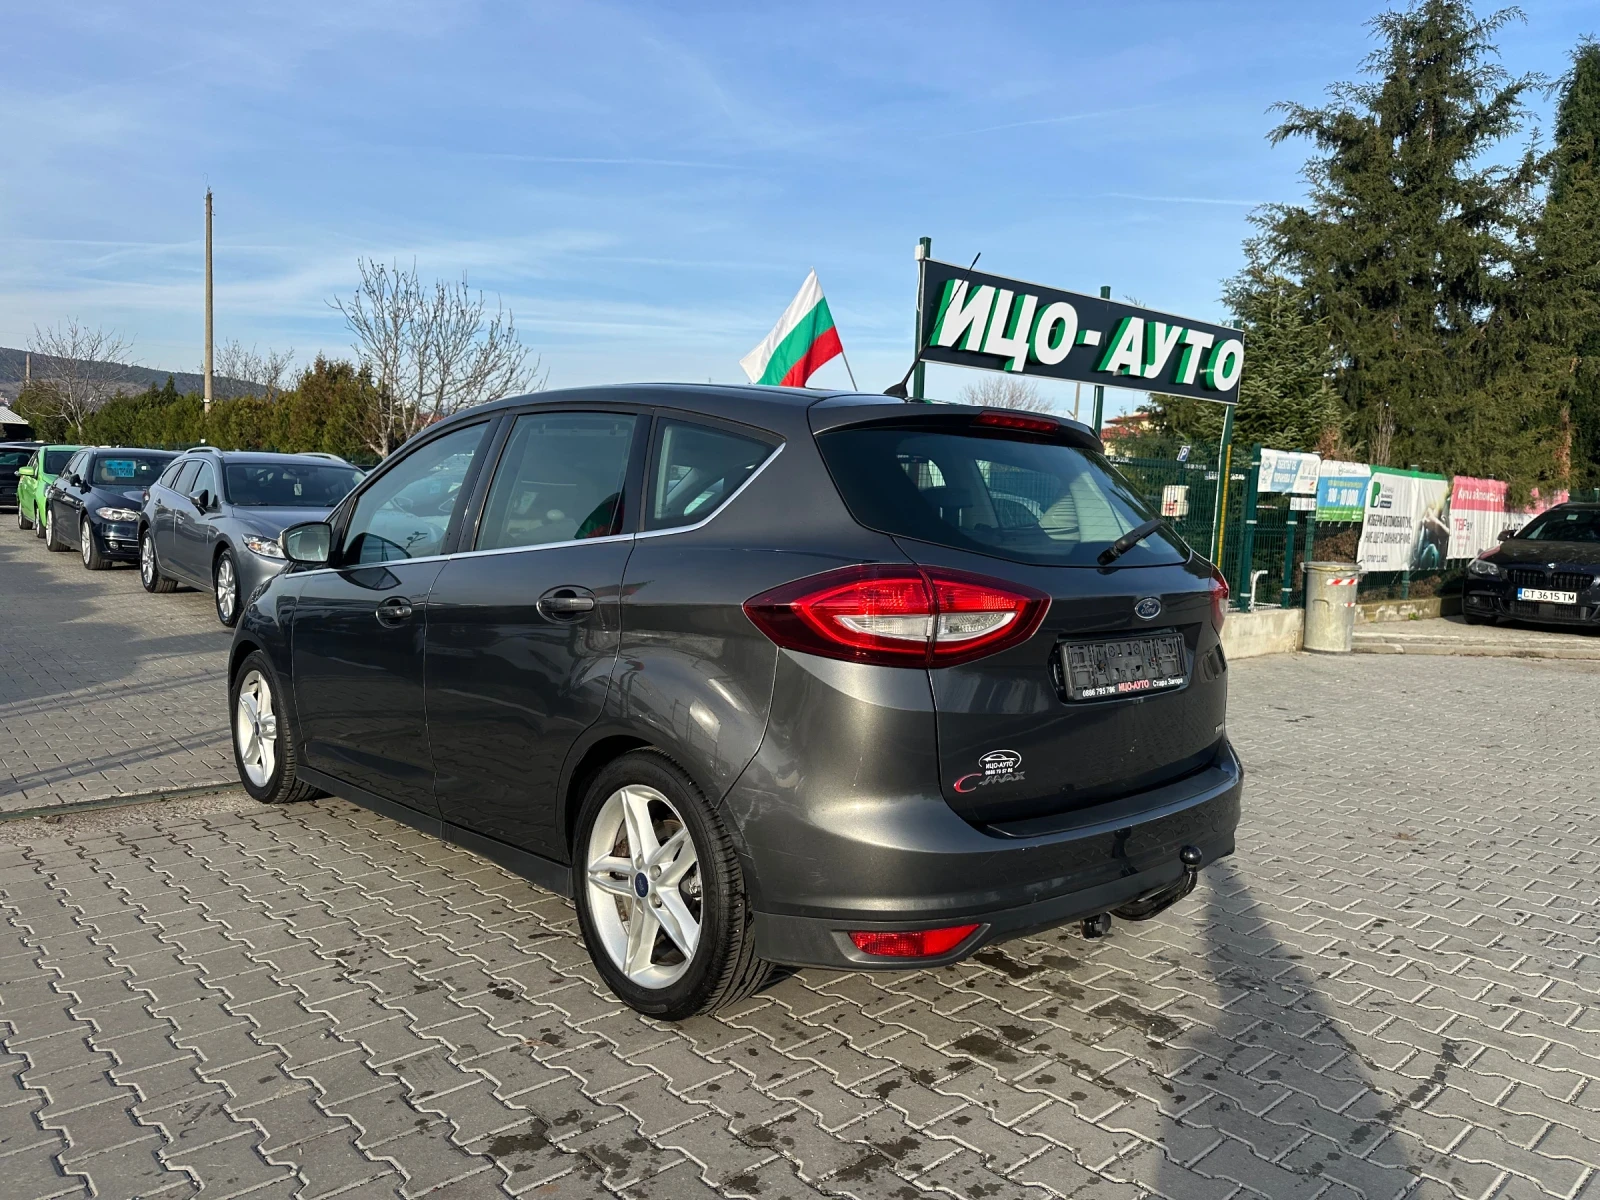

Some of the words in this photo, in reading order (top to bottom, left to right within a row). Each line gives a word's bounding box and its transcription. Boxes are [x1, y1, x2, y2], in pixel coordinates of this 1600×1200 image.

[1179, 447, 1188, 460] P
[1523, 589, 1535, 599] CT
[1537, 590, 1560, 601] 3615
[1562, 593, 1575, 602] TM
[1118, 679, 1150, 692] ИЦО-АУТО
[1152, 679, 1168, 688] Стара
[985, 761, 1014, 770] ИЦО-АУТО
